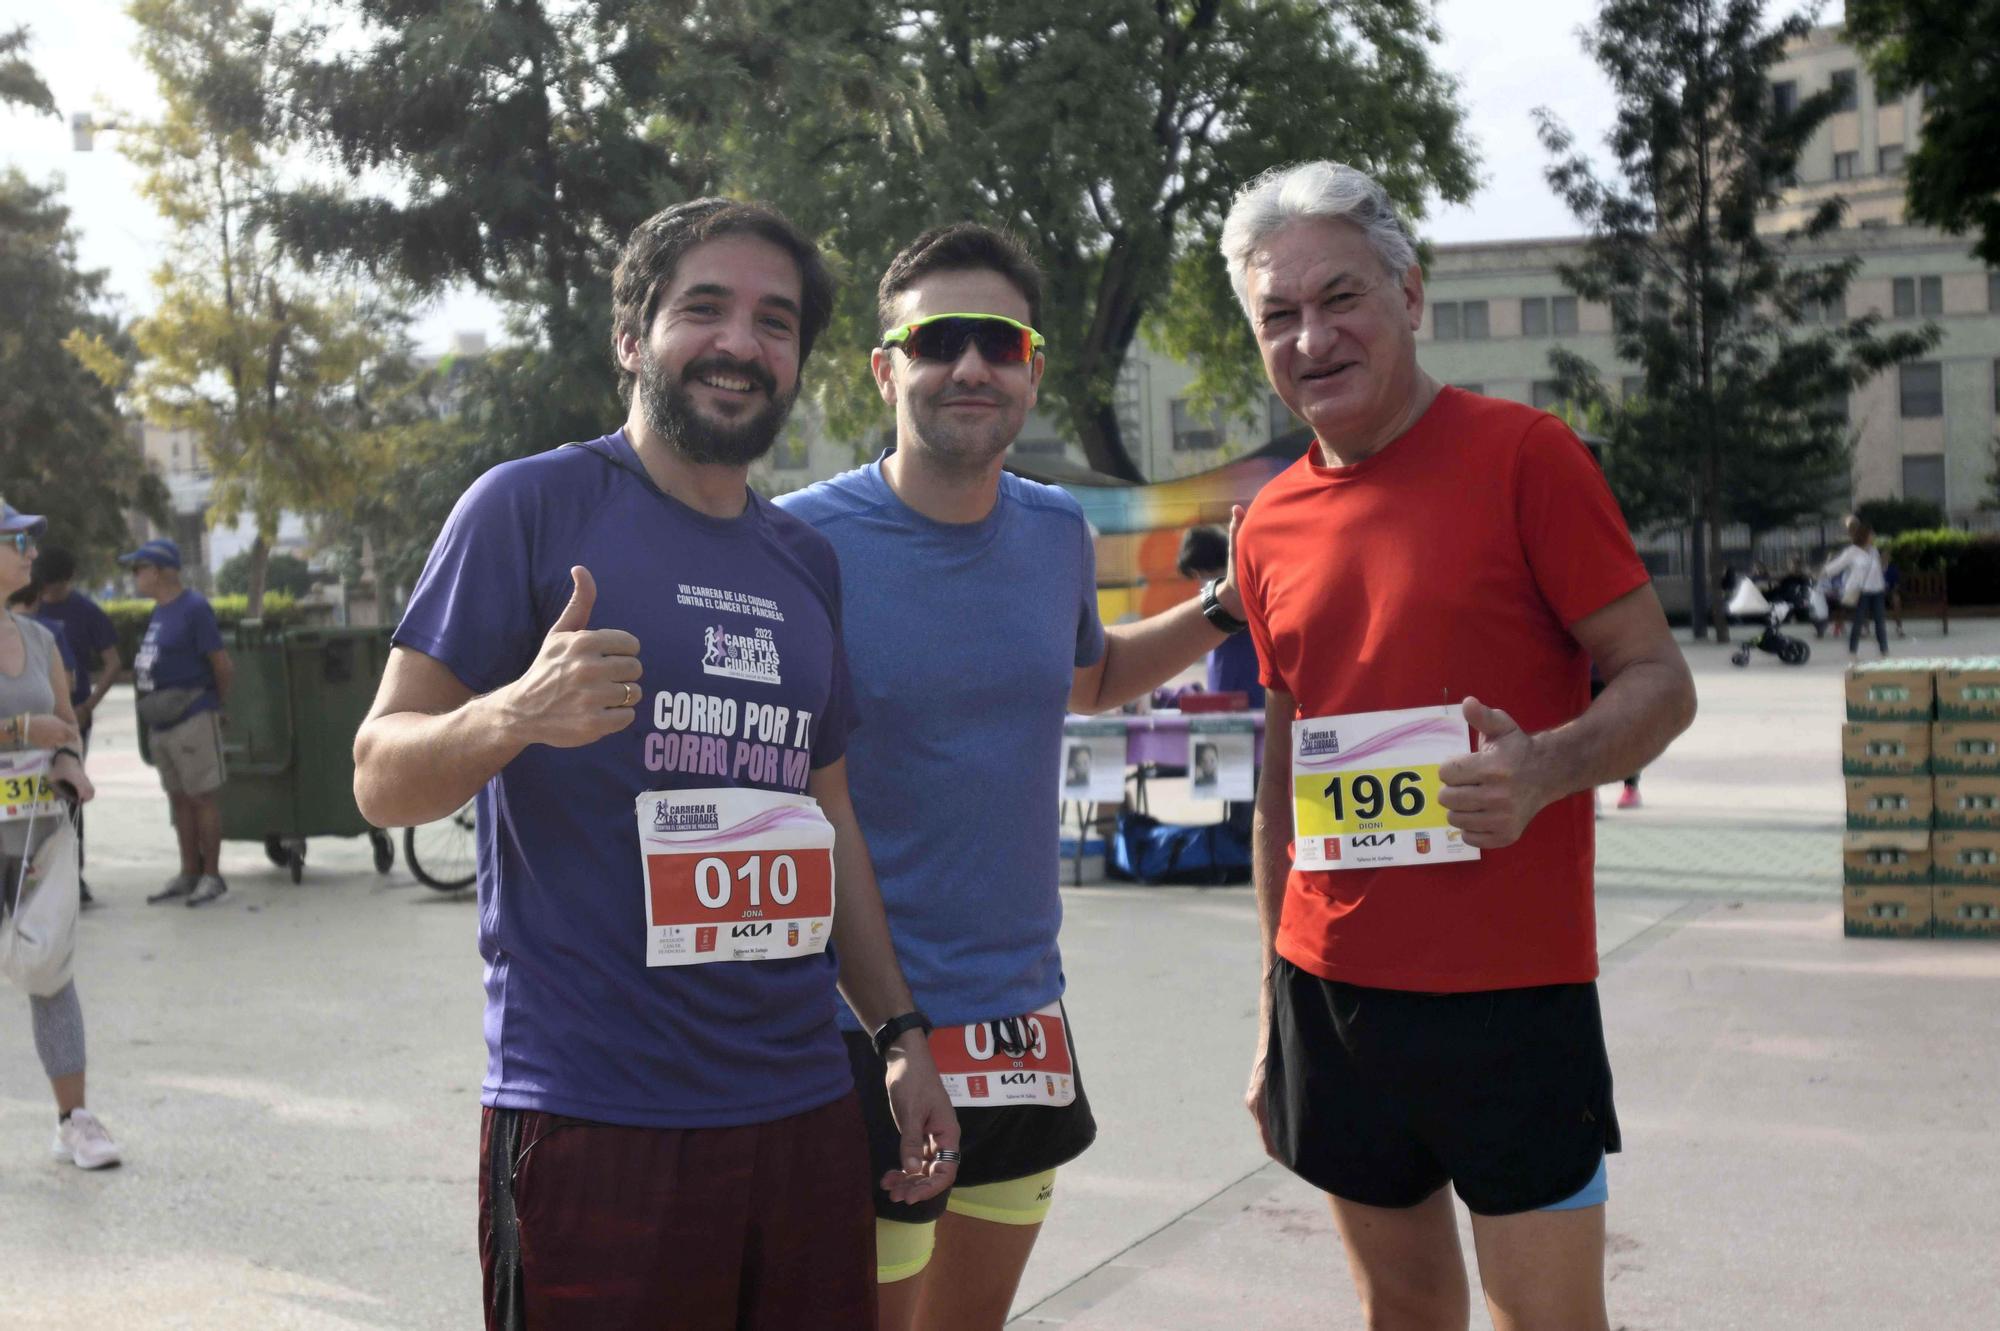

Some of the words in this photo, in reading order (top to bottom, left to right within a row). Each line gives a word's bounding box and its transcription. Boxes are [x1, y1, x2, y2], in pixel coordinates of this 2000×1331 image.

[677, 594, 704, 608] CONTRA
[705, 598, 714, 609] EL
[742, 604, 752, 615] DE
[678, 584, 690, 595] VIII
[692, 586, 724, 600] CARRERA
[724, 590, 734, 601] DE
[734, 592, 748, 604] LAS
[748, 594, 778, 610] CIUDADES
[754, 627, 773, 640] 2022
[724, 633, 777, 654] CARRERA
[740, 648, 756, 662] DE
[759, 651, 780, 665] LAS
[724, 656, 778, 677] CIUDADES
[653, 690, 738, 738] CORRO
[743, 701, 790, 745] POR
[644, 732, 728, 776] CORRO
[732, 741, 778, 784] POR
[1324, 771, 1426, 821] 196
[670, 804, 705, 815] CARRERA
[706, 804, 717, 814] DE
[665, 815, 678, 824] LAS
[680, 814, 719, 824] CIUDADES
[1358, 822, 1384, 830] DIONI
[1352, 833, 1396, 848] KIA
[694, 854, 799, 910] 010
[742, 910, 764, 919] JONA
[731, 922, 772, 938] KIA
[1001, 1073, 1036, 1086] KIA
